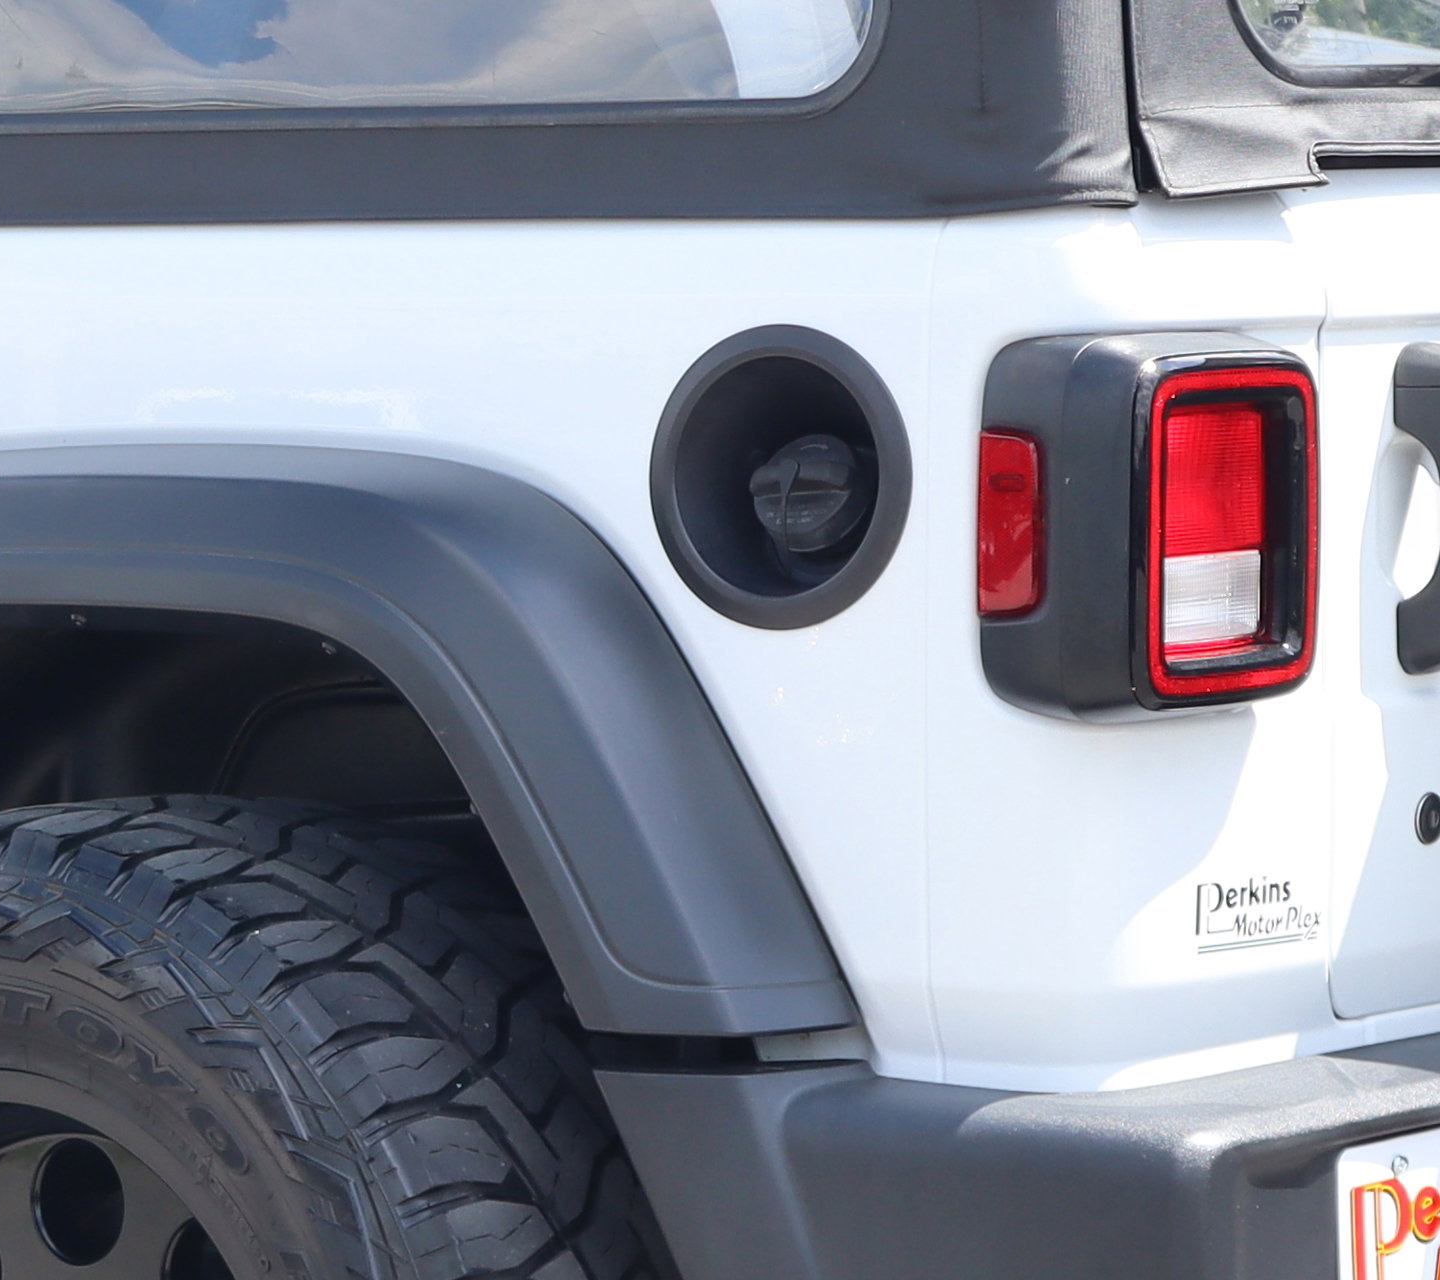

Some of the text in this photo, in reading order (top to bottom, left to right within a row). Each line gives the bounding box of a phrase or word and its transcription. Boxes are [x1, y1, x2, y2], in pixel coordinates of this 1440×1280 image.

[1195, 876, 1292, 936] Perkins
[1232, 905, 1322, 939] Motor Plex
